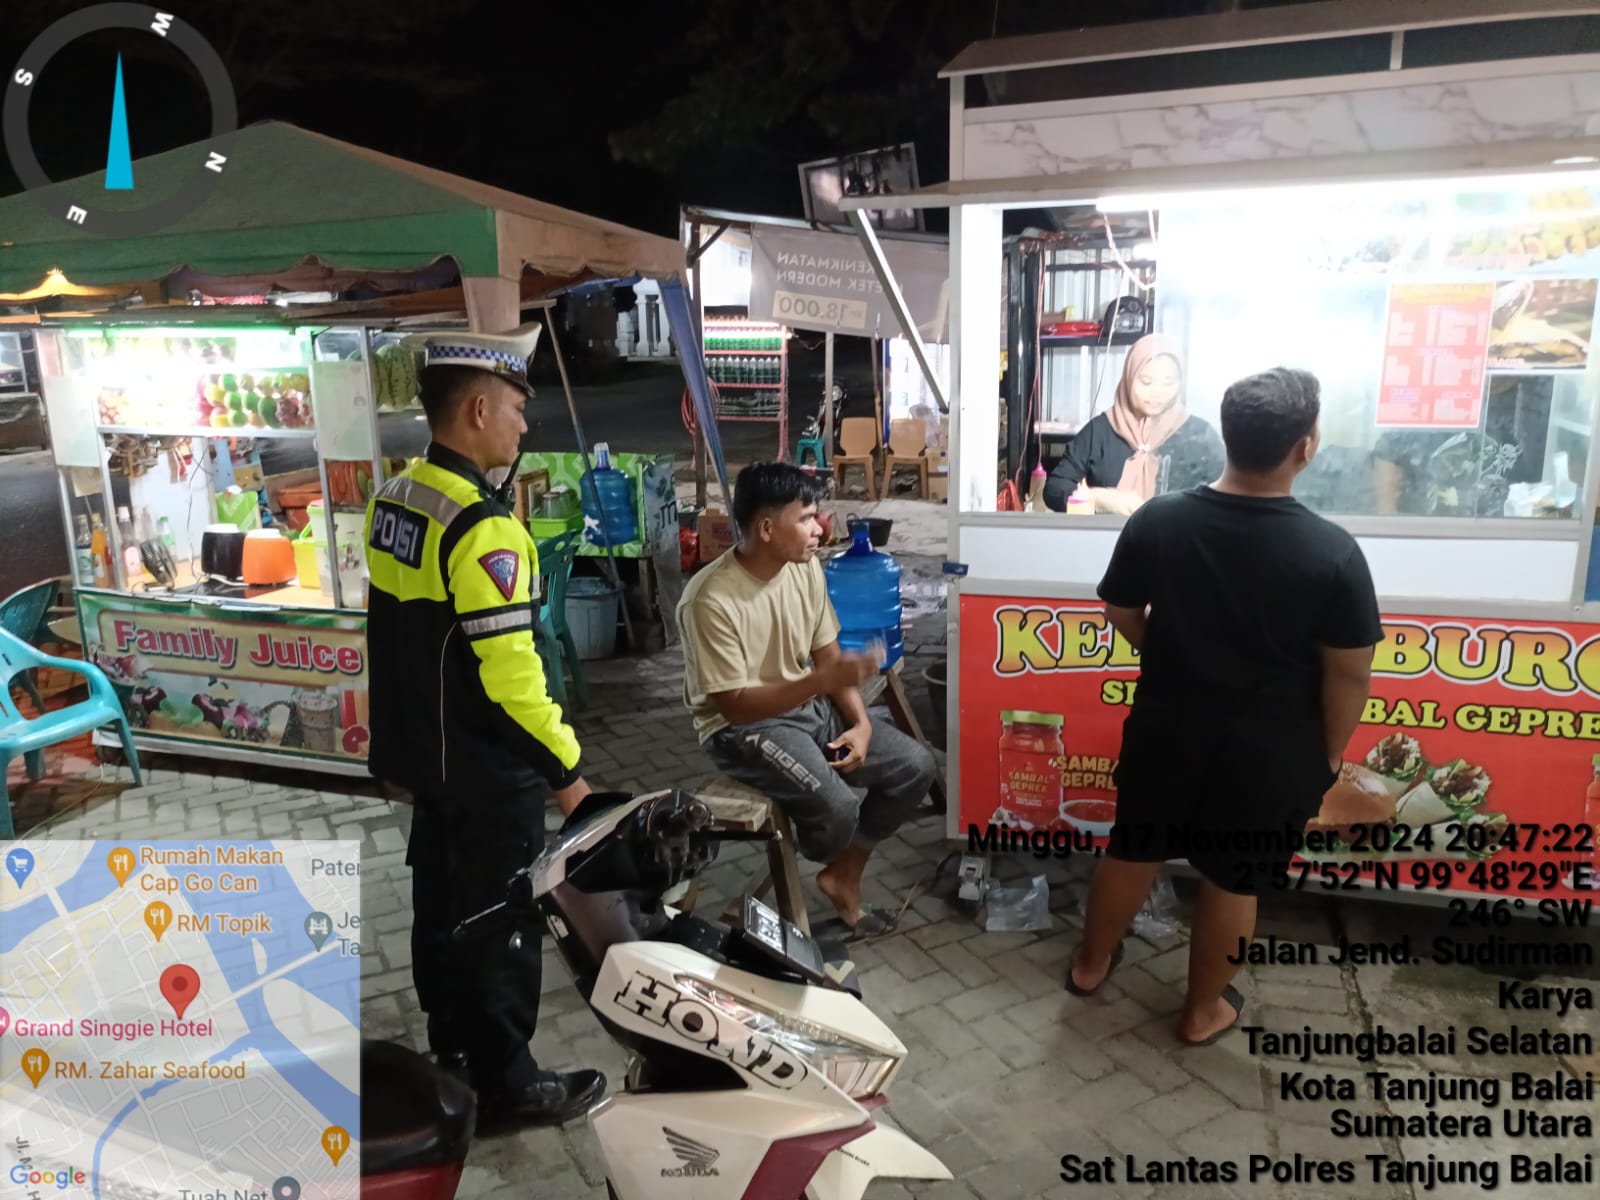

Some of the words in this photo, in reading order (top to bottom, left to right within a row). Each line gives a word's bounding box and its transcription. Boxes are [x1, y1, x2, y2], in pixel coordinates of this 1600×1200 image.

[114, 620, 237, 668] Family
[249, 633, 364, 674] Juice
[761, 739, 822, 793] EIGER
[1057, 754, 1119, 774] SAMB
